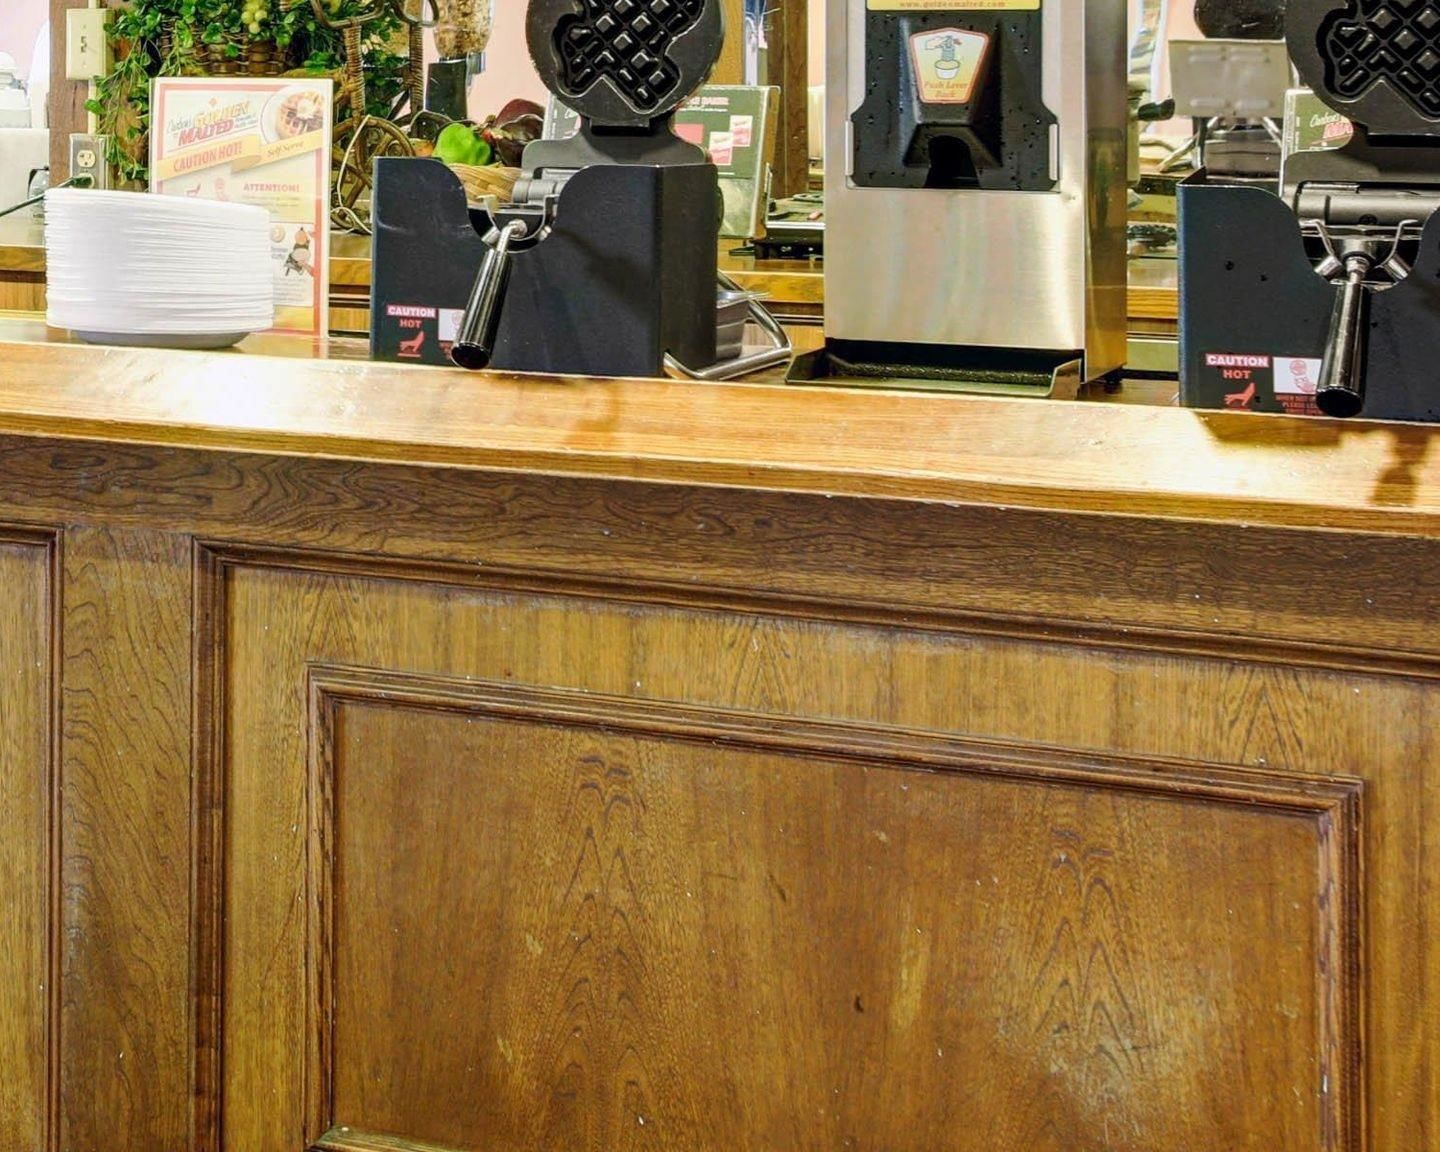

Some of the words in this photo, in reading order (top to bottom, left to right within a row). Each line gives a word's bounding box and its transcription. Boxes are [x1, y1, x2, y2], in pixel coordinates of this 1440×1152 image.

[900, 0, 1006, 8] www.goldenmalted.com
[178, 118, 234, 146] MALTED
[173, 150, 216, 172] CAUTION
[218, 141, 242, 158] HOT!
[268, 147, 281, 158] Self
[282, 140, 304, 153] Serve
[244, 183, 300, 192] ATTENTION!
[388, 306, 436, 318] CAUTION
[400, 319, 422, 328] HOT
[1206, 355, 1269, 368] CAUTION
[1223, 370, 1252, 380] HOT
